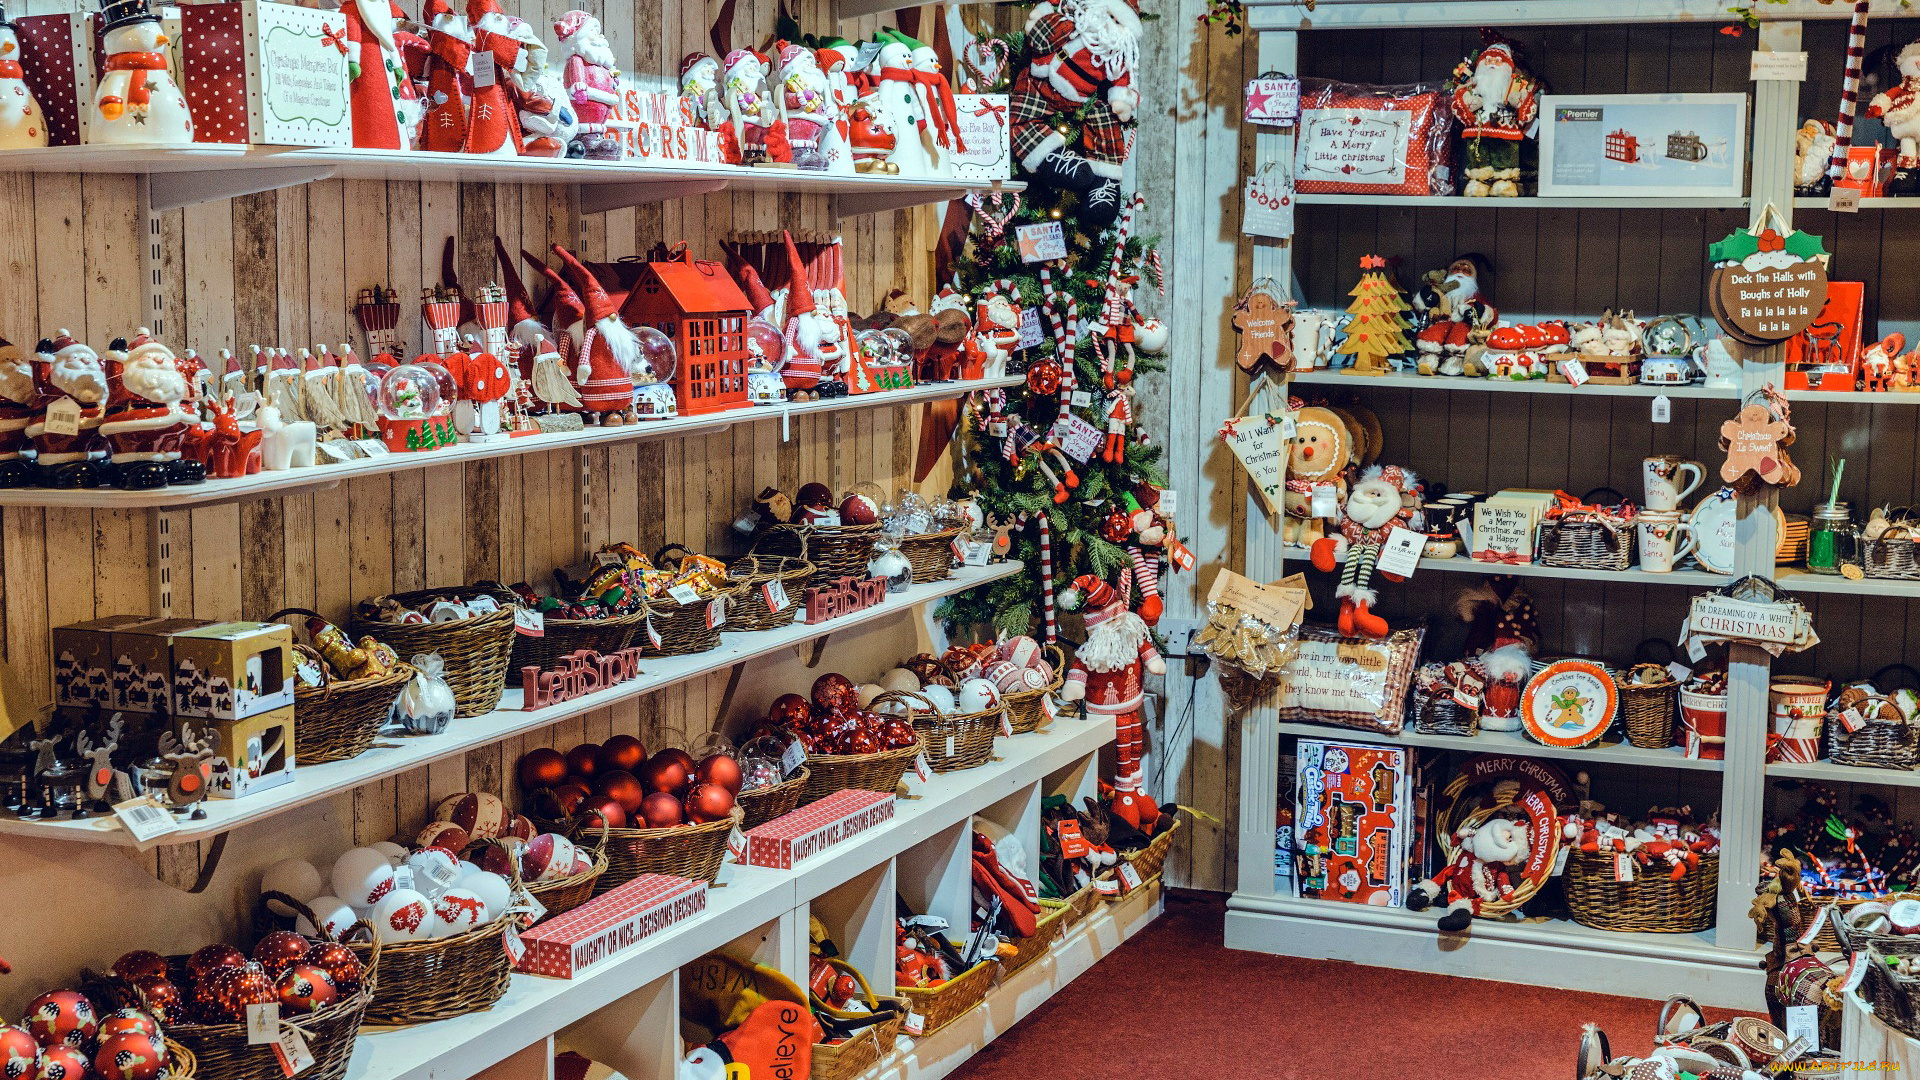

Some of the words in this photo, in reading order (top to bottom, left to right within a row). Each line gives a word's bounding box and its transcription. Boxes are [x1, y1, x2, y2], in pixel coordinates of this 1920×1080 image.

[1264, 82, 1296, 91] SANTA
[1271, 108, 1289, 117] here
[1567, 109, 1599, 118] Premier
[1320, 128, 1343, 137] Have
[1348, 128, 1387, 138] Yourself
[1330, 140, 1338, 149] A
[1341, 141, 1373, 151] Merry
[1314, 152, 1338, 161] Little
[1031, 225, 1061, 236] SANTA
[1731, 274, 1752, 284] Deck
[1756, 273, 1769, 283] the
[1773, 271, 1794, 282] Halls
[1797, 270, 1816, 281] with
[1740, 289, 1771, 301] Boughs
[1774, 288, 1784, 298] of
[1787, 287, 1810, 298] Holly
[1741, 308, 1750, 318] Fa
[1754, 307, 1762, 317] la
[1765, 306, 1773, 316] la
[1777, 306, 1785, 316] la
[1788, 305, 1796, 315] la
[1800, 305, 1808, 315] la
[1246, 318, 1276, 328] Welcome
[1759, 322, 1767, 332] la
[1770, 321, 1778, 331] la
[1782, 321, 1790, 331] la
[1251, 327, 1275, 339] Friends
[1071, 420, 1100, 441] SANTA
[1737, 430, 1772, 440] Christmas
[1236, 432, 1247, 444] All
[1248, 430, 1253, 439] I
[1253, 441, 1263, 451] for
[1737, 442, 1747, 452] Is
[1749, 441, 1773, 452] Sweet
[1245, 450, 1281, 465] Christmas
[1255, 470, 1261, 478] is
[1263, 466, 1277, 475] You
[1649, 479, 1661, 487] For
[1647, 487, 1665, 497] Santa
[1481, 508, 1492, 517] We
[1495, 508, 1511, 518] Wish
[1514, 510, 1527, 519] You
[1496, 517, 1517, 527] Merry
[1478, 525, 1511, 534] Christmas
[1512, 528, 1526, 536] and
[1496, 534, 1519, 544] Happy
[1647, 540, 1660, 548] For
[1487, 542, 1502, 551] New
[1643, 549, 1663, 558] Santa
[1695, 604, 1706, 613] I'M
[1708, 605, 1746, 619] DREAMING
[1747, 611, 1758, 620] OF
[1759, 613, 1765, 621] A
[1769, 614, 1794, 625] WHITE
[1700, 616, 1786, 638] CHRISTMAS
[1311, 651, 1320, 661] in
[1322, 654, 1336, 665] my
[1338, 655, 1358, 664] own
[1360, 655, 1382, 667] little
[1316, 667, 1331, 679] but
[1334, 669, 1350, 681] it's
[1551, 674, 1574, 685] Cookies
[1587, 676, 1600, 690] Santa
[1284, 683, 1303, 695] they
[1304, 683, 1329, 696] know
[1331, 688, 1346, 697] me
[1475, 758, 1517, 776] MERRY
[1519, 760, 1567, 801] CHRISTMAS
[1522, 788, 1546, 816] MERRY
[793, 832, 817, 863] NAUGHTY
[818, 829, 826, 852] OR
[869, 798, 895, 828] DECISIONS
[1531, 817, 1550, 871] CHRISTMAS
[574, 934, 606, 972] NAUGHTY
[607, 929, 617, 955] OR
[674, 887, 706, 923] DECISIONS
[769, 1008, 799, 1080] elieve
